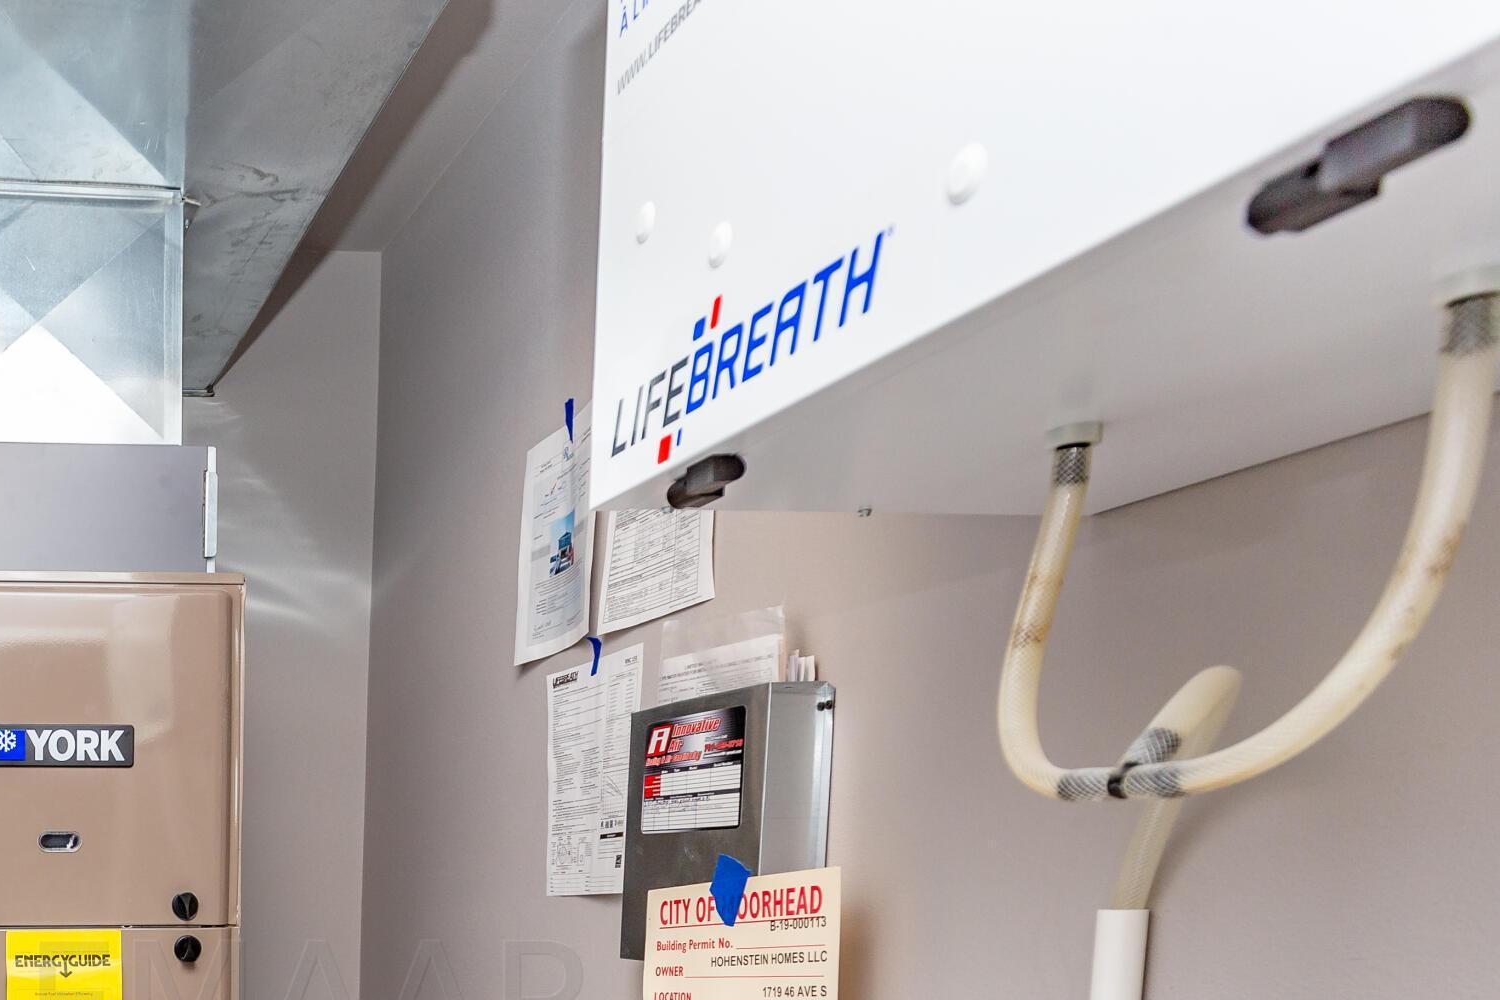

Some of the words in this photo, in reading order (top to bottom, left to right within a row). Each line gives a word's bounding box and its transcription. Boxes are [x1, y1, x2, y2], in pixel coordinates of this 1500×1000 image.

[610, 229, 886, 458] LIFEBREATH
[672, 717, 722, 737] Innovative
[26, 728, 126, 762] YORK
[659, 898, 692, 926] CITY
[695, 896, 717, 922] OF
[722, 885, 823, 921] OORHEAD
[770, 915, 827, 932] B-19-000113
[656, 940, 687, 953] Building
[689, 938, 715, 950] Permit
[718, 938, 734, 949] No.
[15, 954, 111, 971] ENERGYGUIDE
[711, 954, 769, 967] HOHENSTEIN
[771, 952, 805, 966] HOMES
[807, 950, 828, 963] LLC
[655, 966, 684, 977] OWNER
[762, 986, 782, 998] 1719
[784, 986, 795, 998] 46
[797, 986, 818, 998] AVE
[820, 985, 828, 997] S
